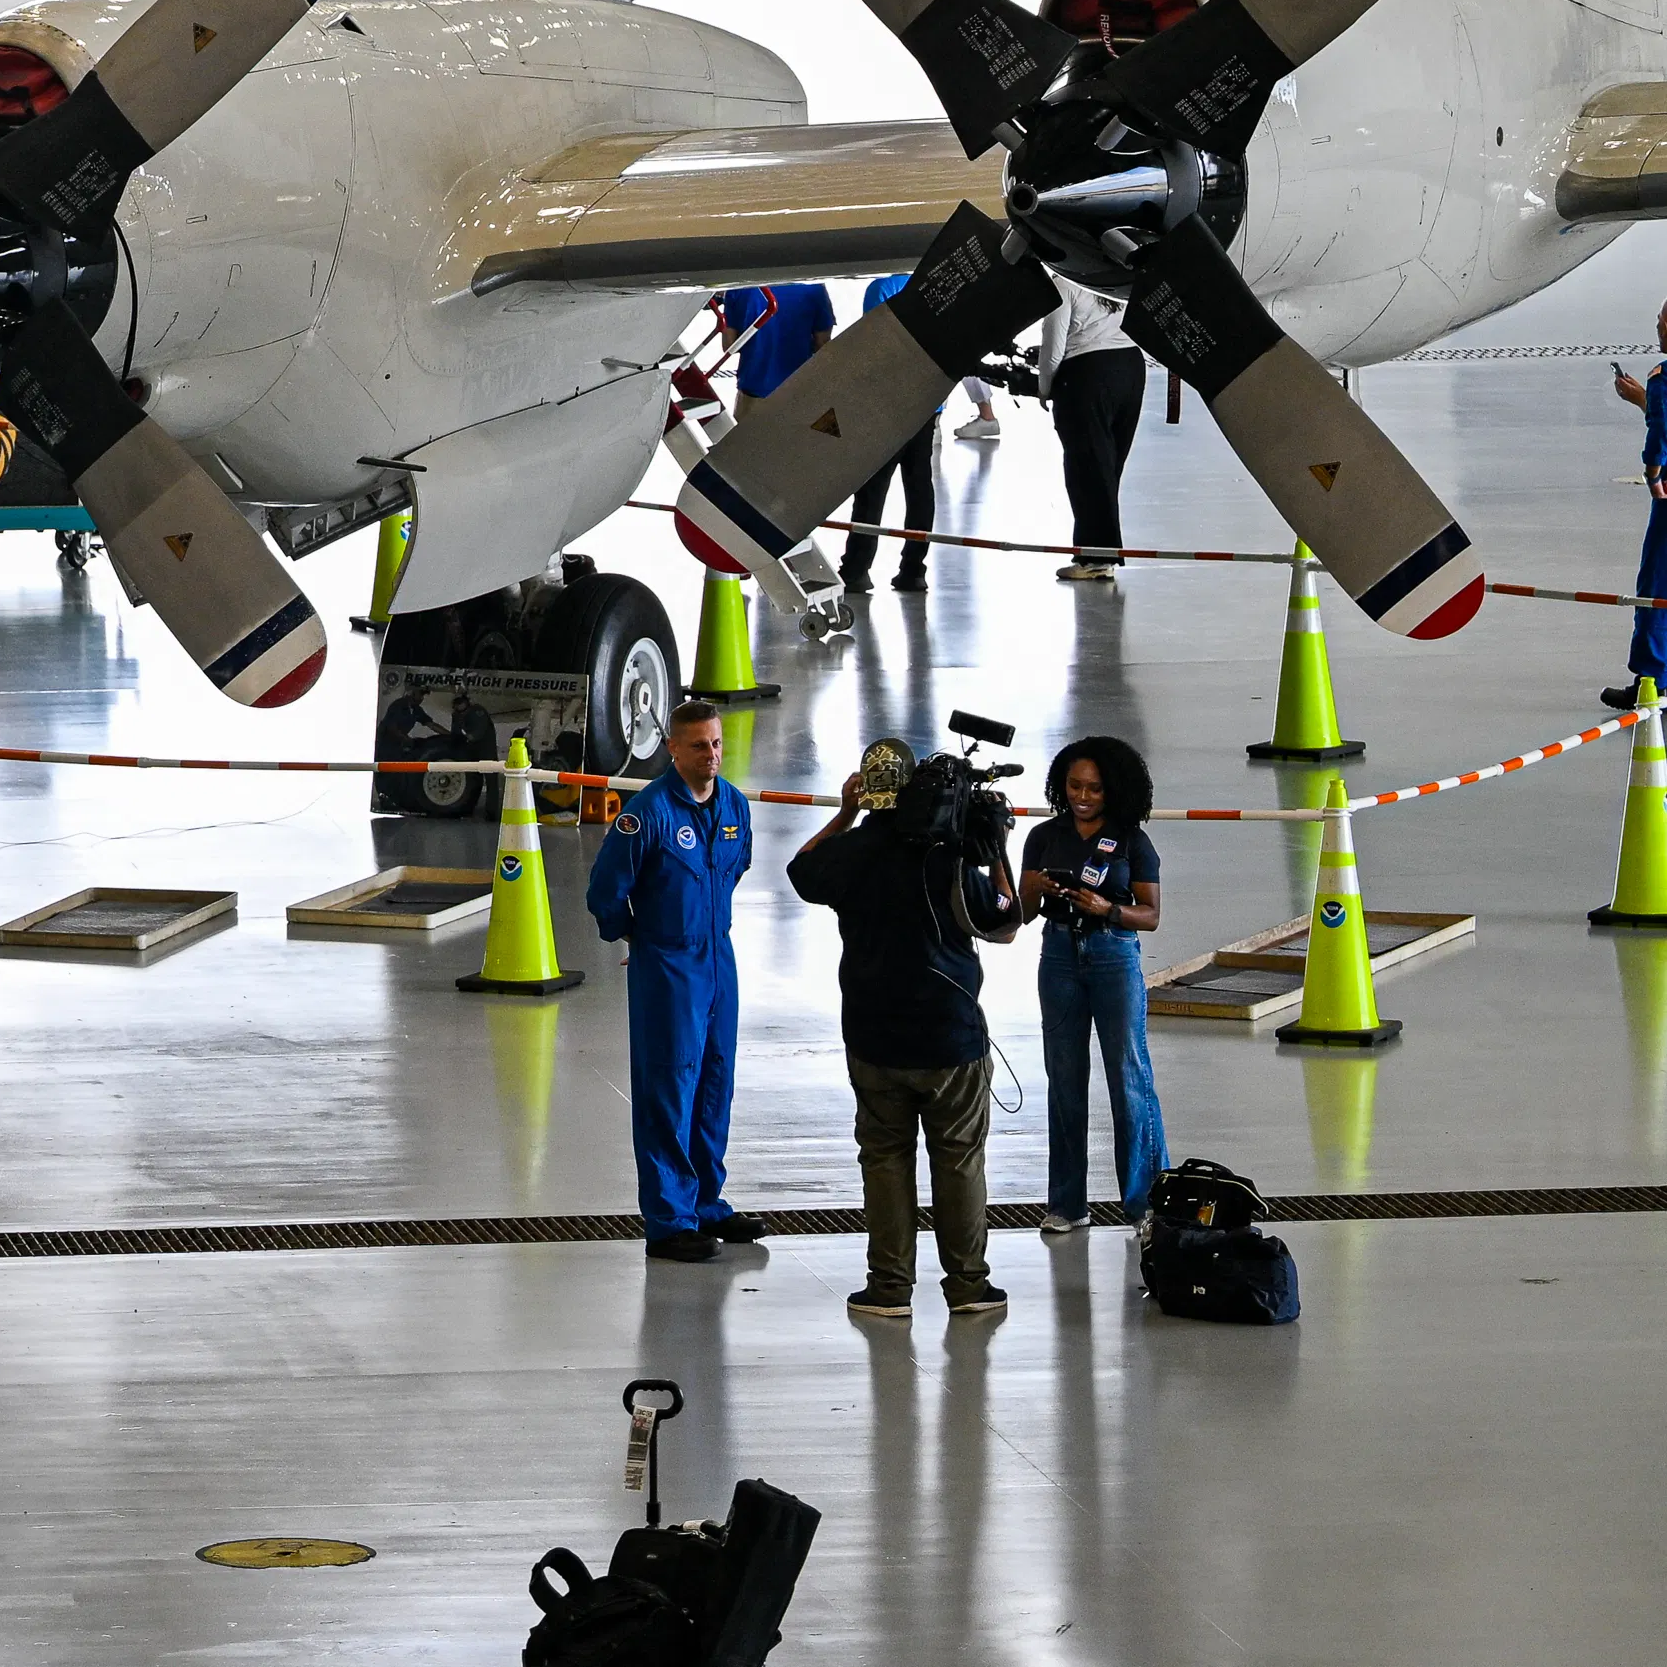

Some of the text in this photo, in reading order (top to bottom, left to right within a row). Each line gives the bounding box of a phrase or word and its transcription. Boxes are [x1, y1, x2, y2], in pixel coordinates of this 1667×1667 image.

[466, 675, 502, 688] HIGH
[505, 677, 578, 692] PRESSURE
[1084, 869, 1098, 878] FOX
